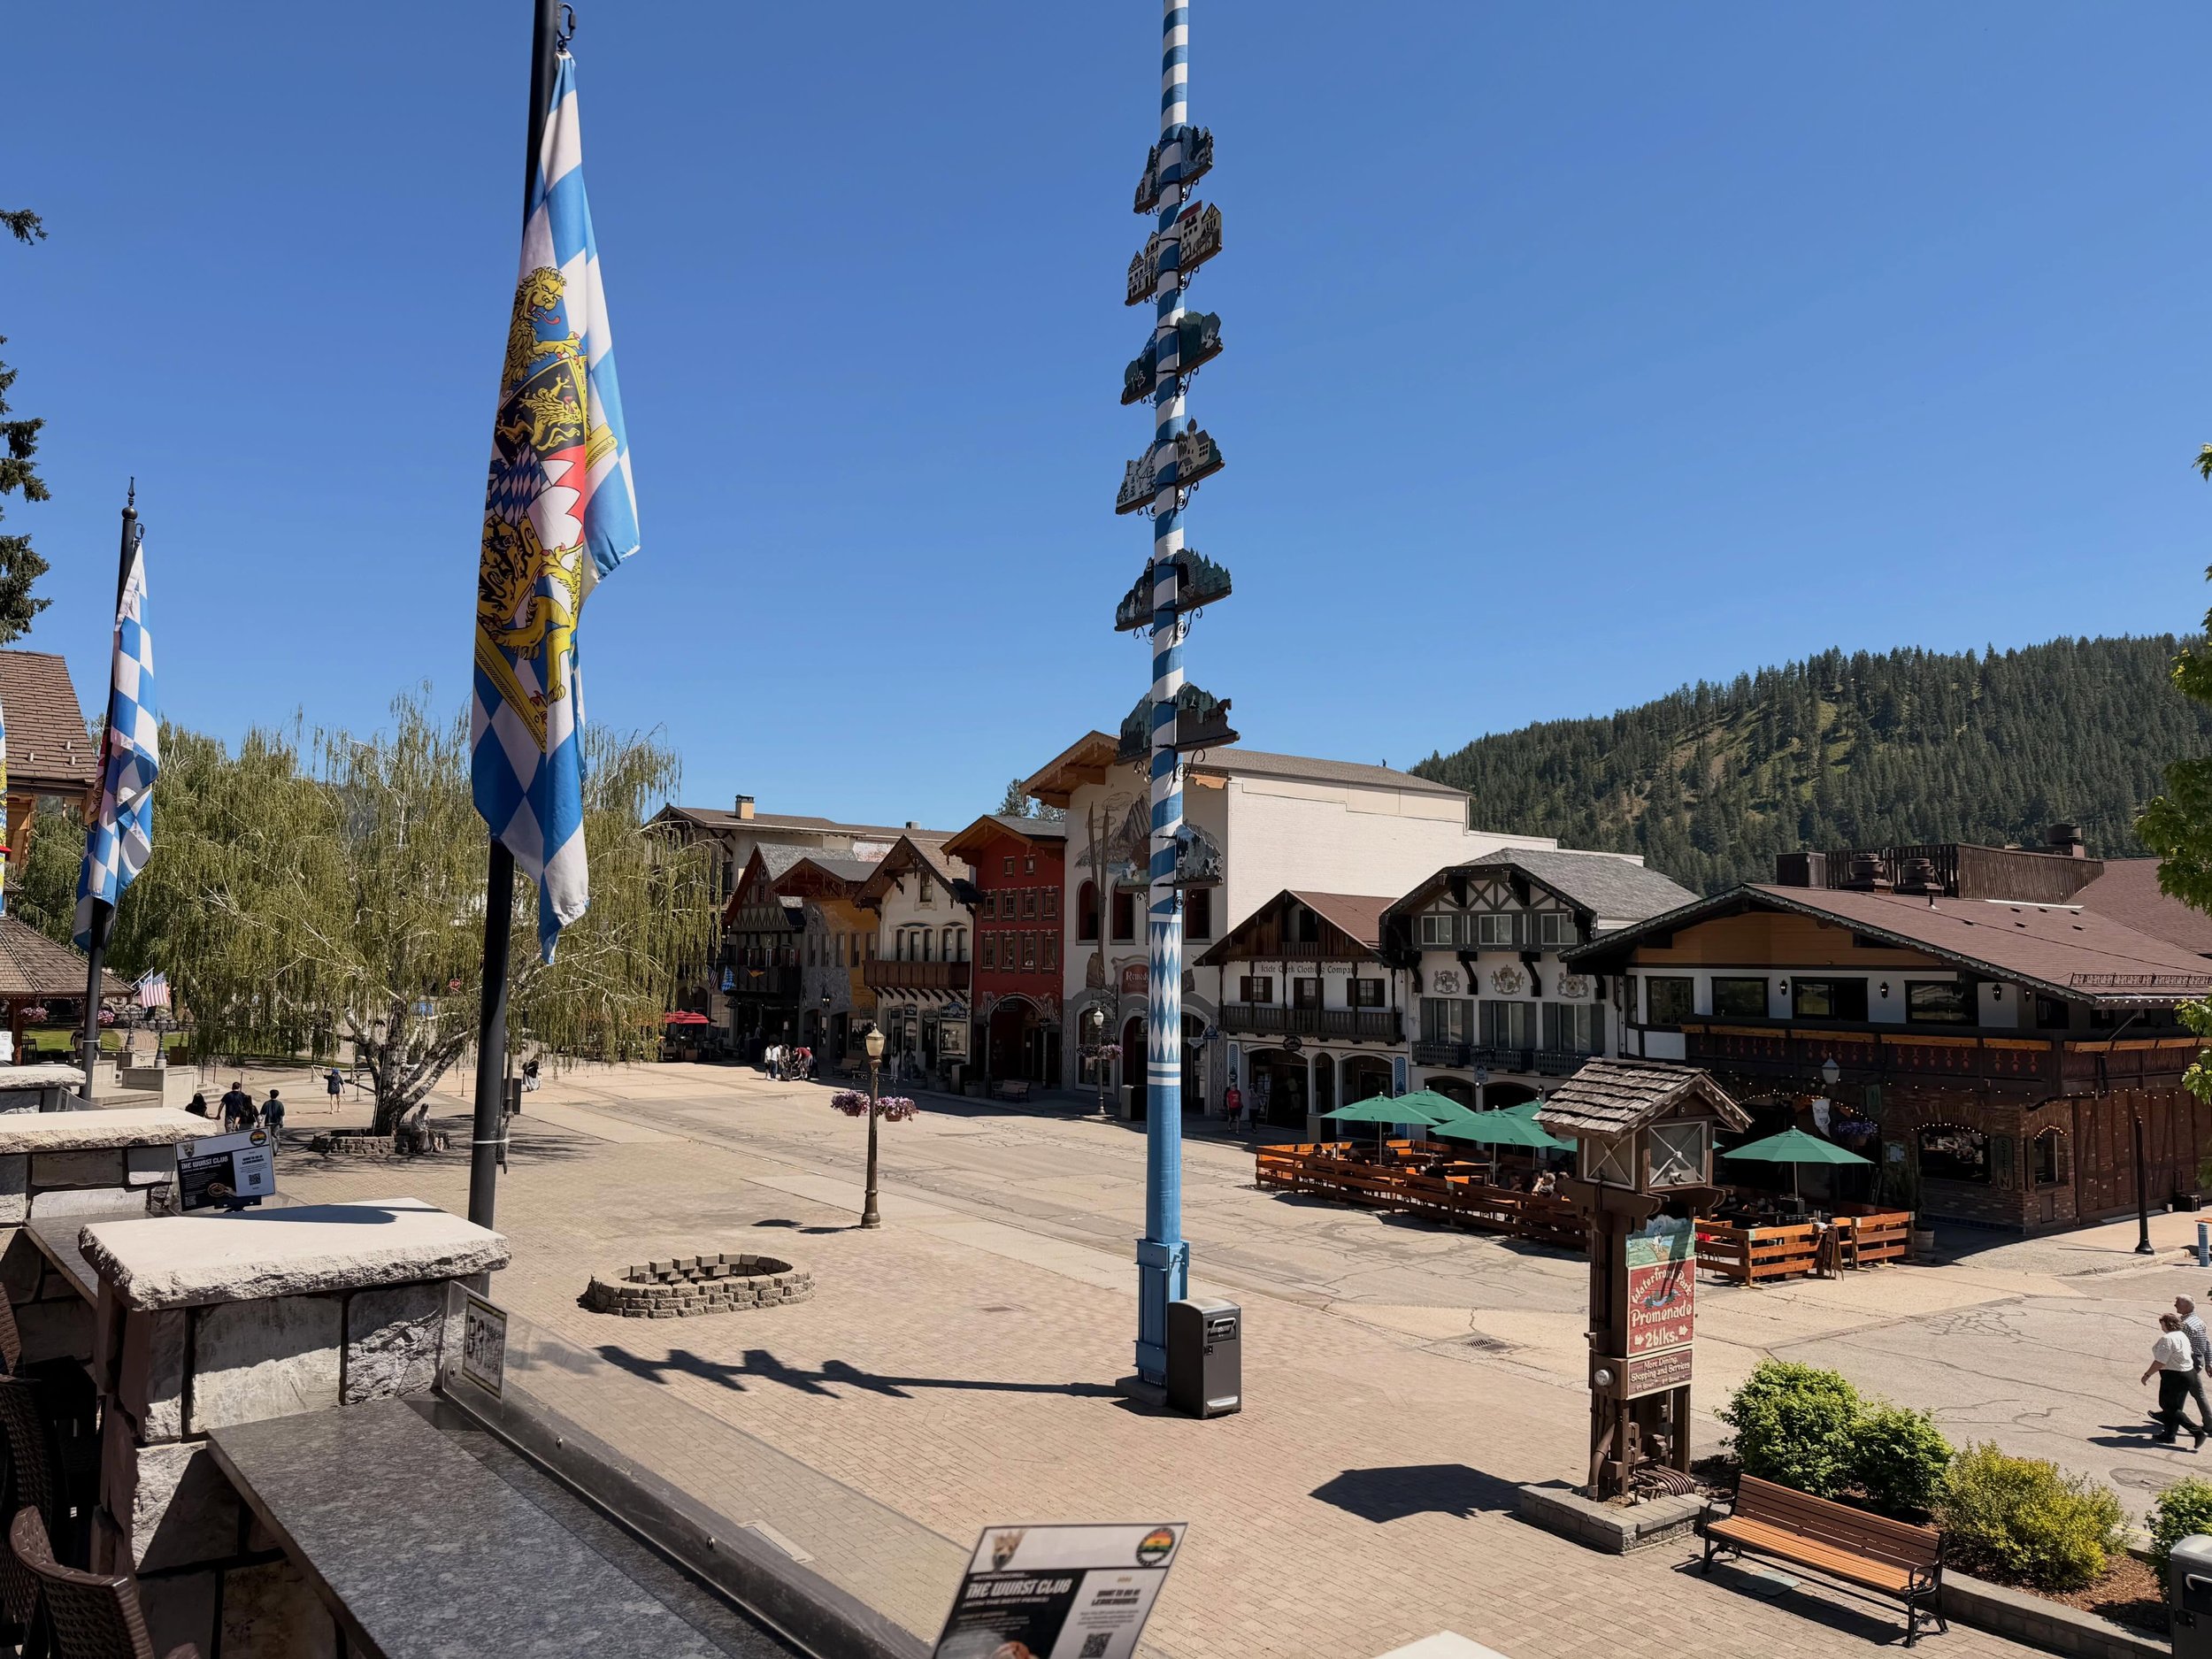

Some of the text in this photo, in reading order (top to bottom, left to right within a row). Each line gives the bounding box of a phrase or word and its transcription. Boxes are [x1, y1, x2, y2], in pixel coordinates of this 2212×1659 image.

[1278, 964, 1295, 973] Cek
[1296, 964, 1325, 974] Clothig
[1327, 965, 1355, 975] Compa
[1631, 1267, 1694, 1303] Waterfront Park
[1631, 1300, 1692, 1327] Promenade
[1631, 1370, 1656, 1382] Shopping
[1657, 1366, 1668, 1376] and
[1668, 1362, 1691, 1373] Services
[1644, 1361, 1658, 1370] More
[965, 1578, 1072, 1599] THE WURST CLUB
